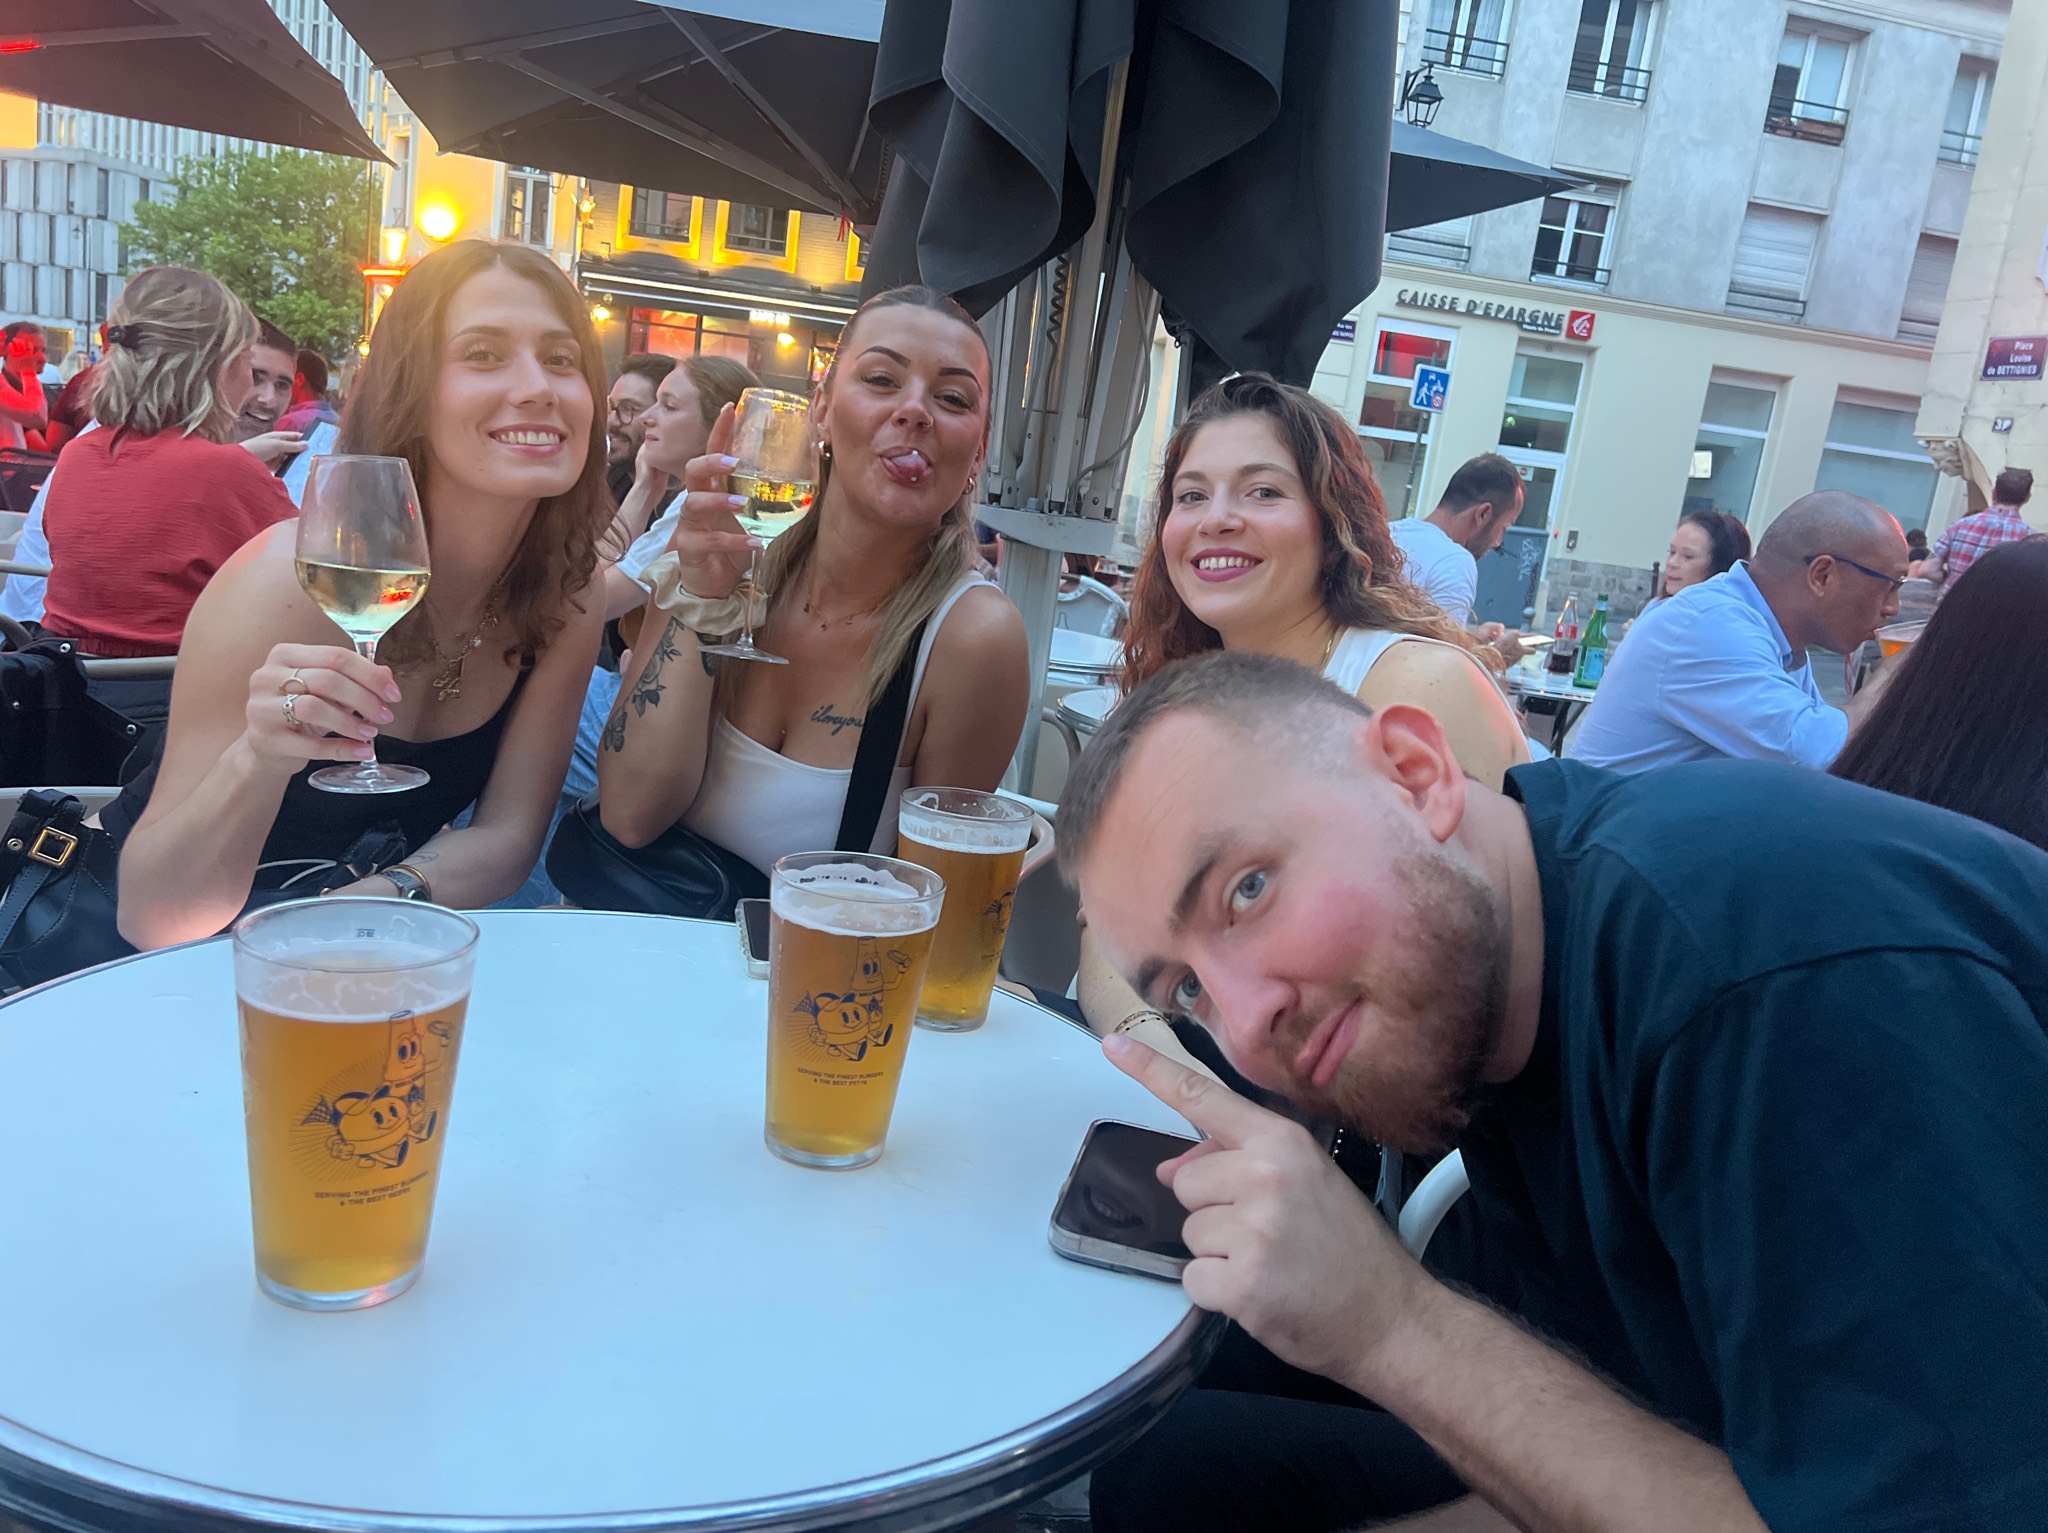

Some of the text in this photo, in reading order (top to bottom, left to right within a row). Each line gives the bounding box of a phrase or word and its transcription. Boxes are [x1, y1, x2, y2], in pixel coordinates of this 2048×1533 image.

[1397, 288, 1565, 326] CAISSE D'EPARGNE
[2014, 341, 2034, 350] Place
[2009, 353, 2033, 363] Louise
[1986, 364, 2037, 375] de BETTIGNIES
[798, 1067, 822, 1078] SERVING
[353, 1189, 370, 1197] THE
